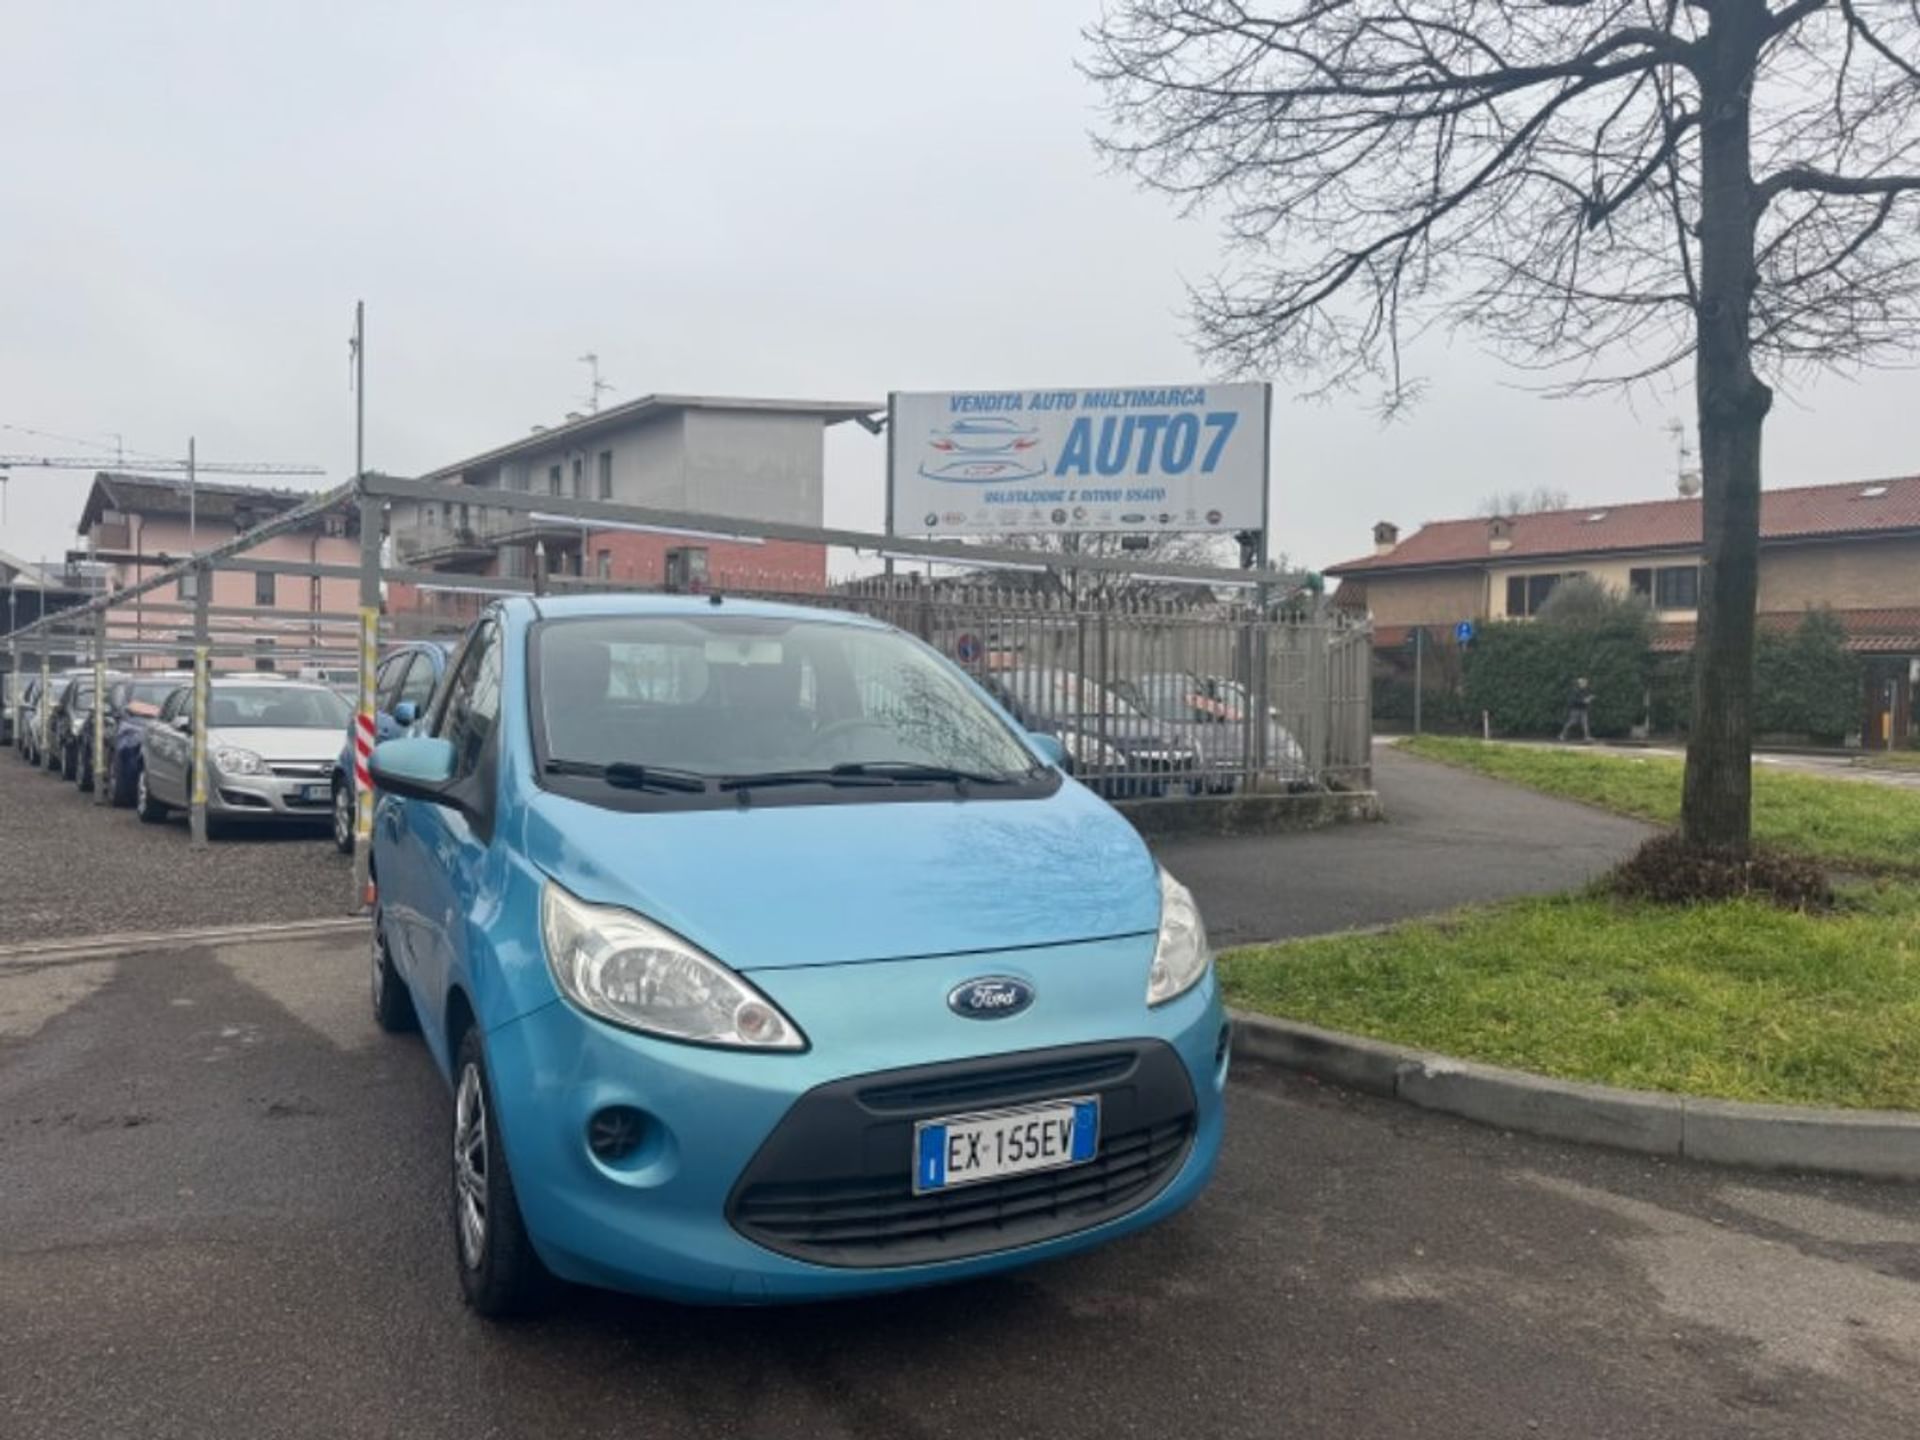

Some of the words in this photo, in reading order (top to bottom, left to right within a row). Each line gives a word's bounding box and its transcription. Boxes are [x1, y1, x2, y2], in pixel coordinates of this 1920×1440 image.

[950, 395, 1022, 412] VENDITA
[1028, 392, 1076, 410] AUTO
[1081, 388, 1206, 409] MULTIMARCA
[1055, 412, 1238, 476] AUTO7
[970, 984, 1016, 1008] Ford
